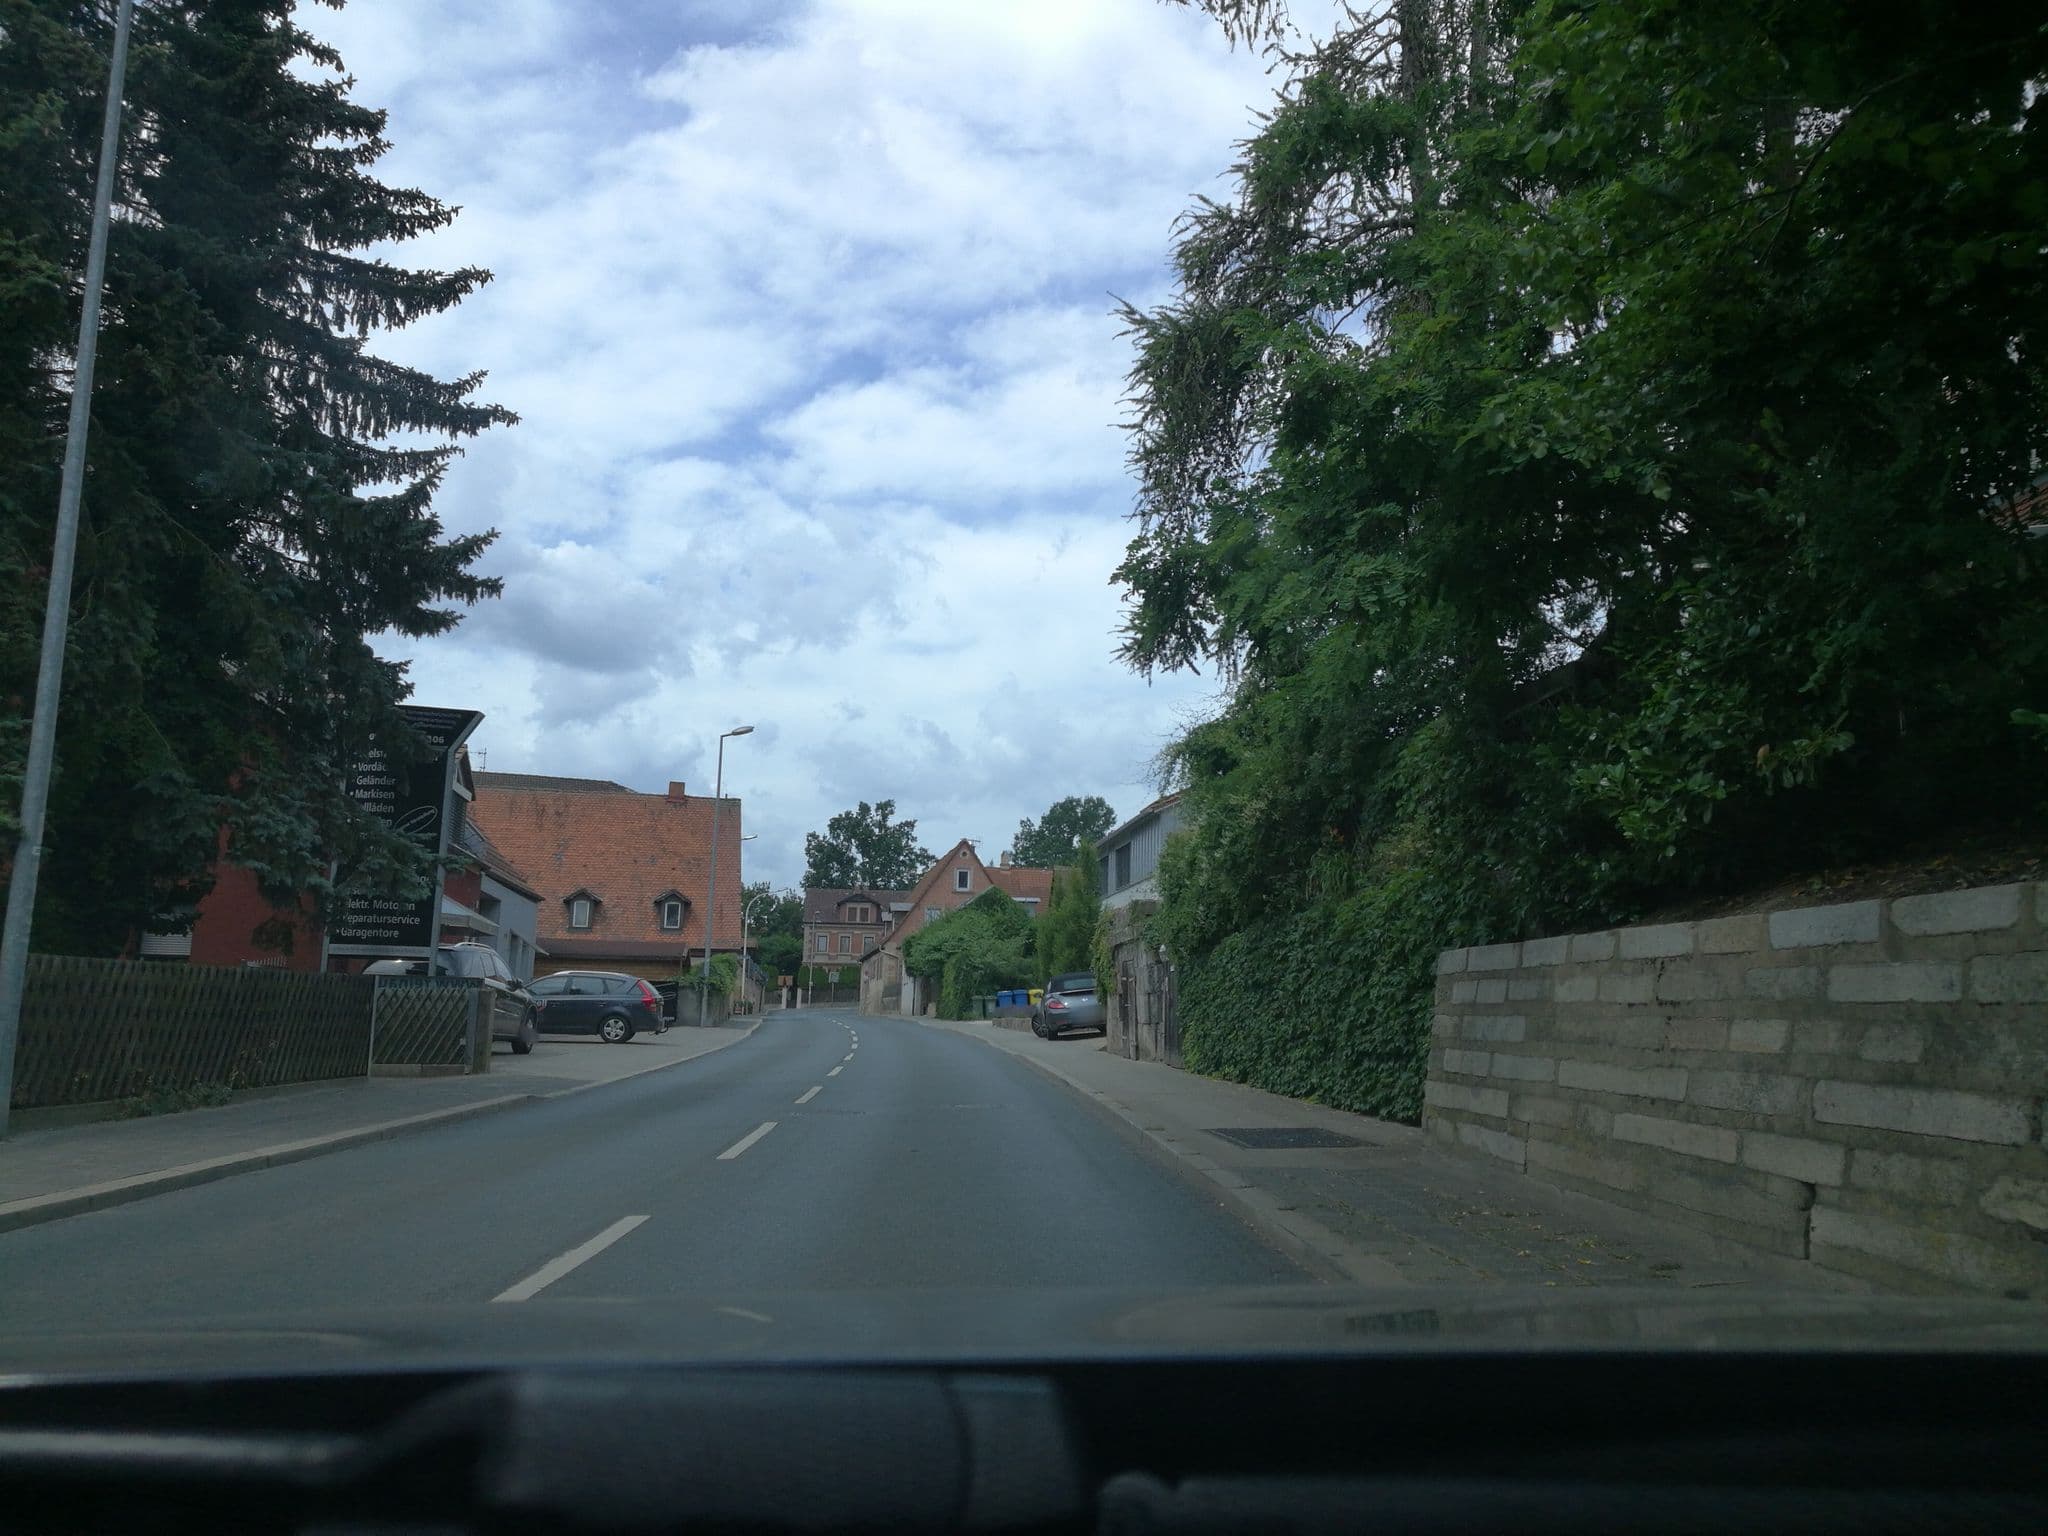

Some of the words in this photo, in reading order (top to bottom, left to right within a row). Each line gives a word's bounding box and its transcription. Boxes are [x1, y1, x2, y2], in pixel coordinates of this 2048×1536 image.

[355, 788, 395, 799] Markisen
[347, 898, 370, 909] lektr.
[373, 899, 415, 911] Moton
[341, 927, 400, 939] Garagentore
